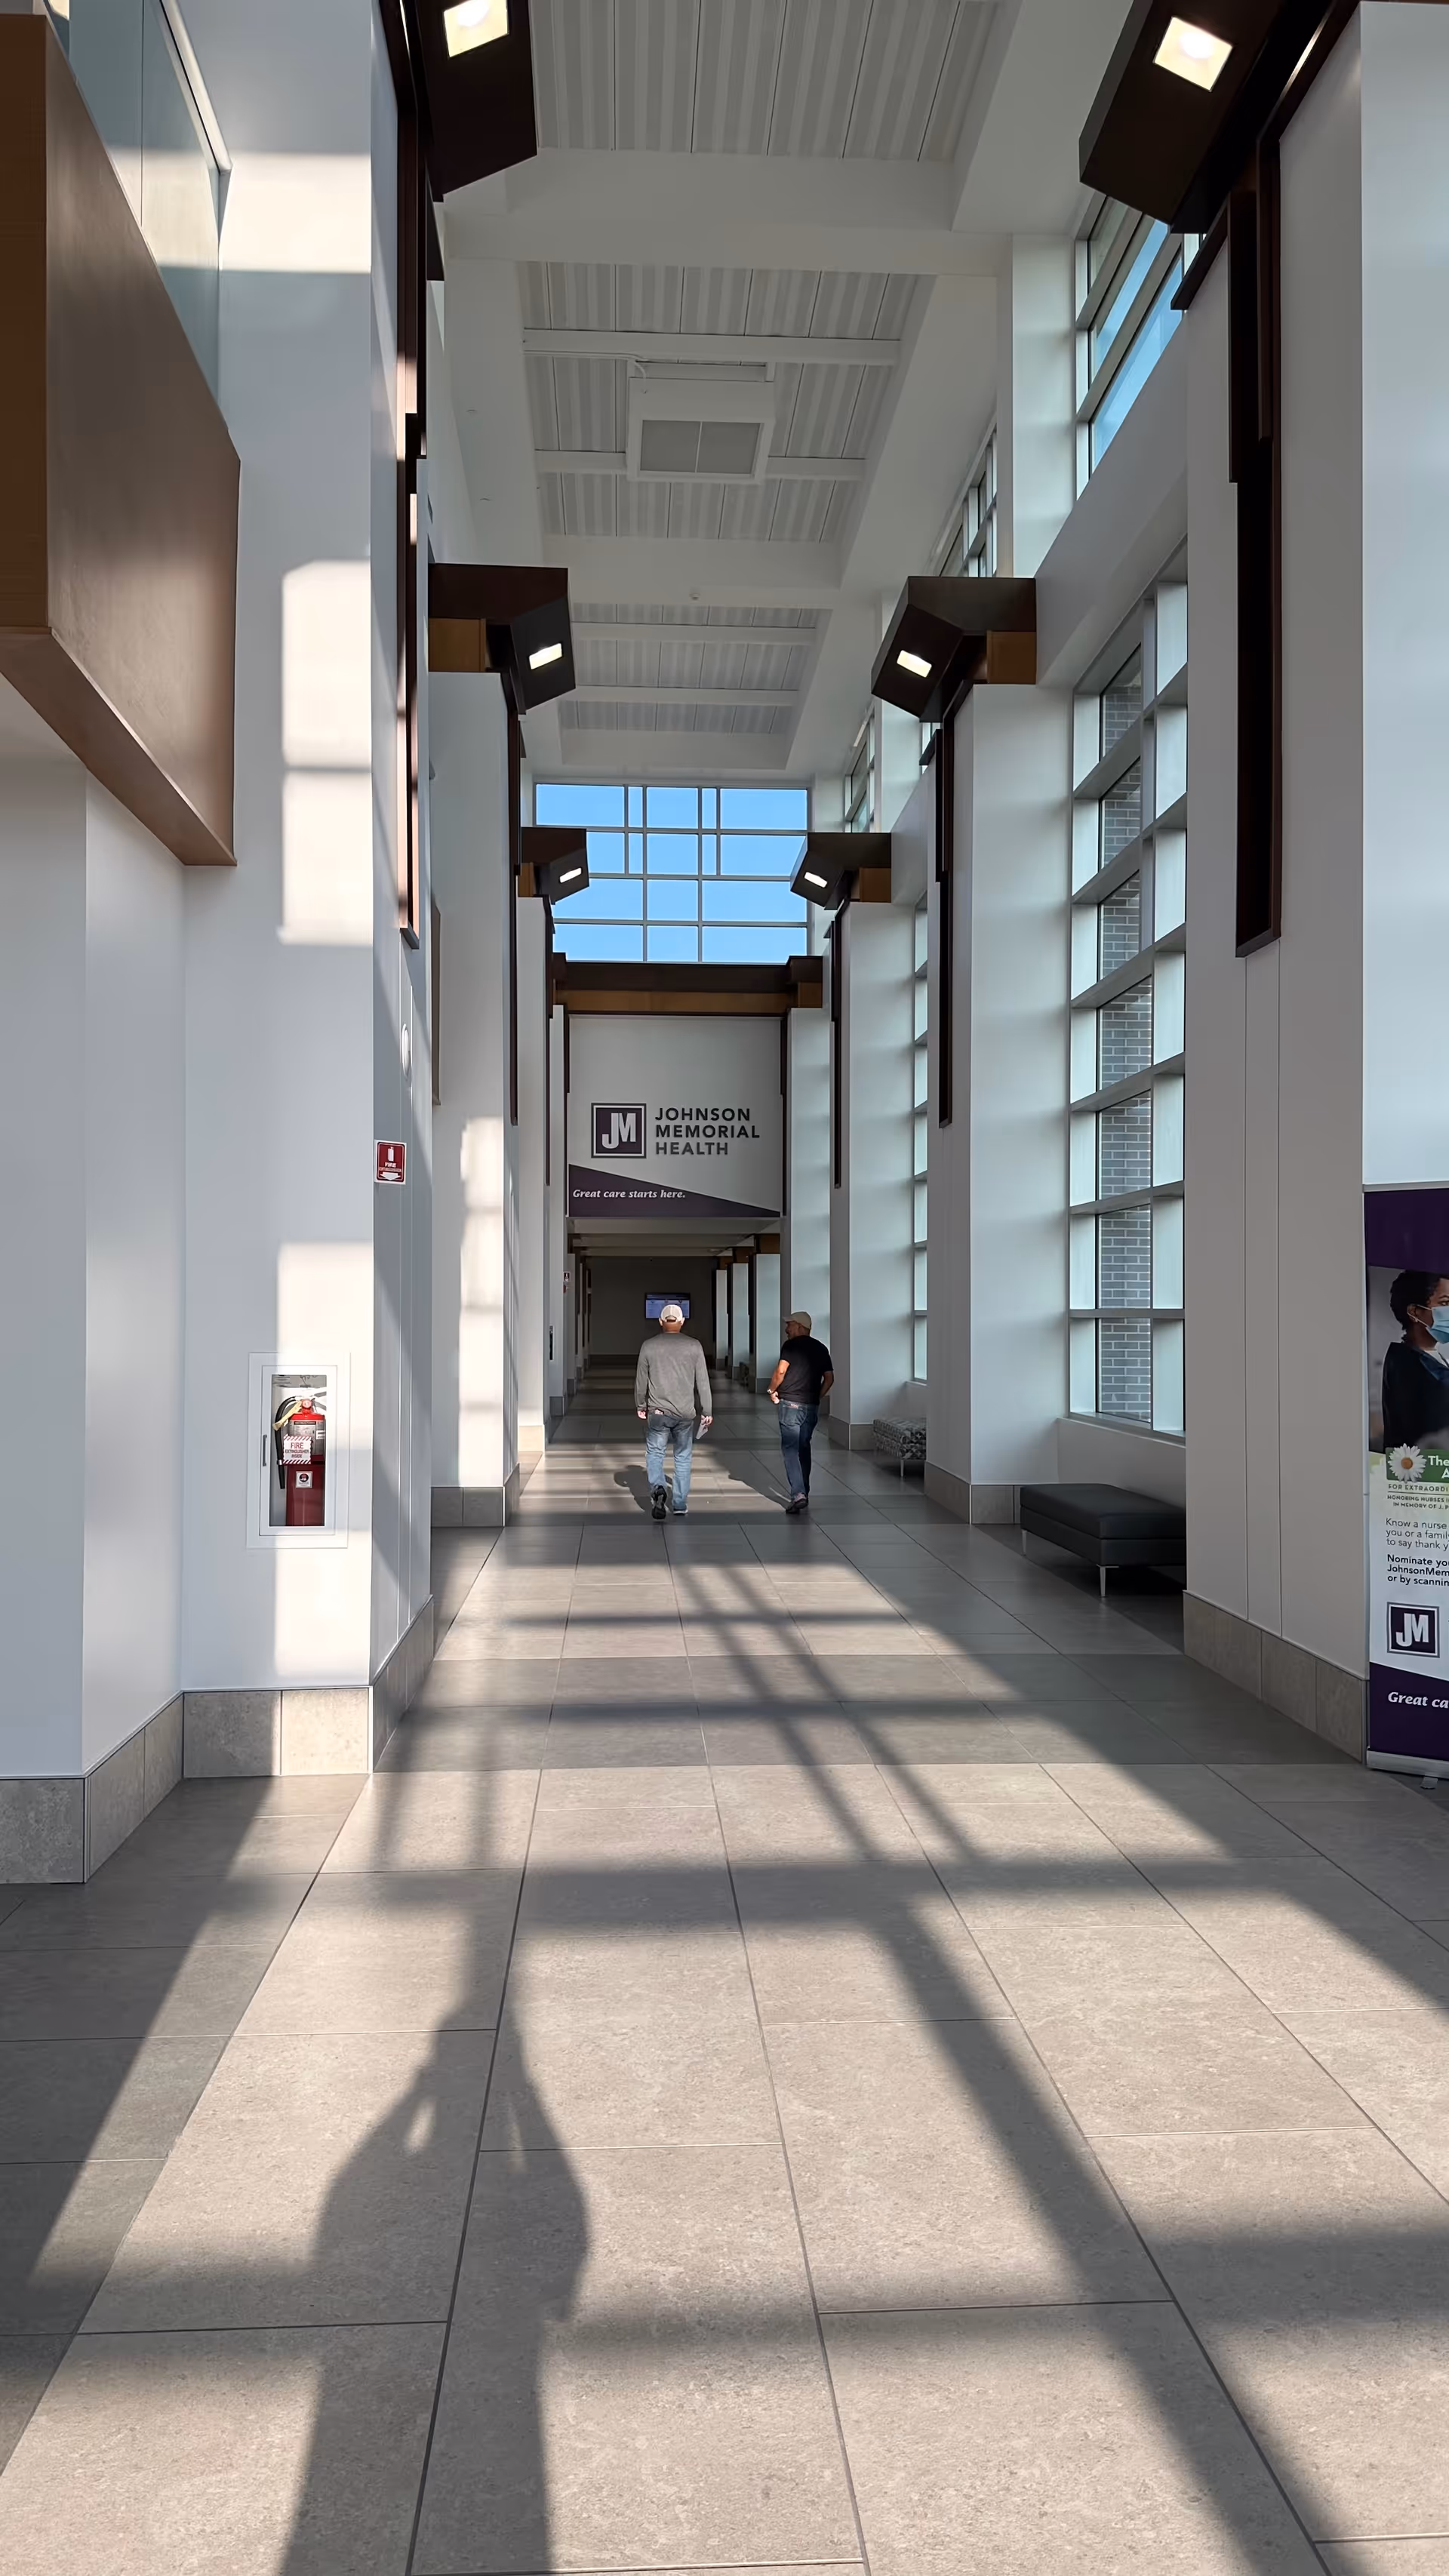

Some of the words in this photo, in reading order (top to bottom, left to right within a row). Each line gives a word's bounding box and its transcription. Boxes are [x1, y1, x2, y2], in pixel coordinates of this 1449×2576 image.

[655, 1107, 750, 1122] JOHNSON
[601, 1113, 636, 1149] JM
[655, 1125, 760, 1138] MEMORIAL
[655, 1142, 728, 1155] HEALTH
[573, 1190, 601, 1199] Great
[629, 1190, 657, 1199] starts
[660, 1190, 686, 1199] here.
[1427, 1455, 1449, 1467] The
[1386, 1518, 1411, 1528] Know
[1398, 1540, 1412, 1549] say
[1415, 1540, 1441, 1550] thank
[1387, 1554, 1432, 1565] Nominate
[1435, 1559, 1449, 1568] yo
[1400, 1574, 1411, 1586] by
[1395, 1612, 1429, 1647] JM
[1388, 1691, 1428, 1707] Great
[1432, 1699, 1449, 1709] ca
